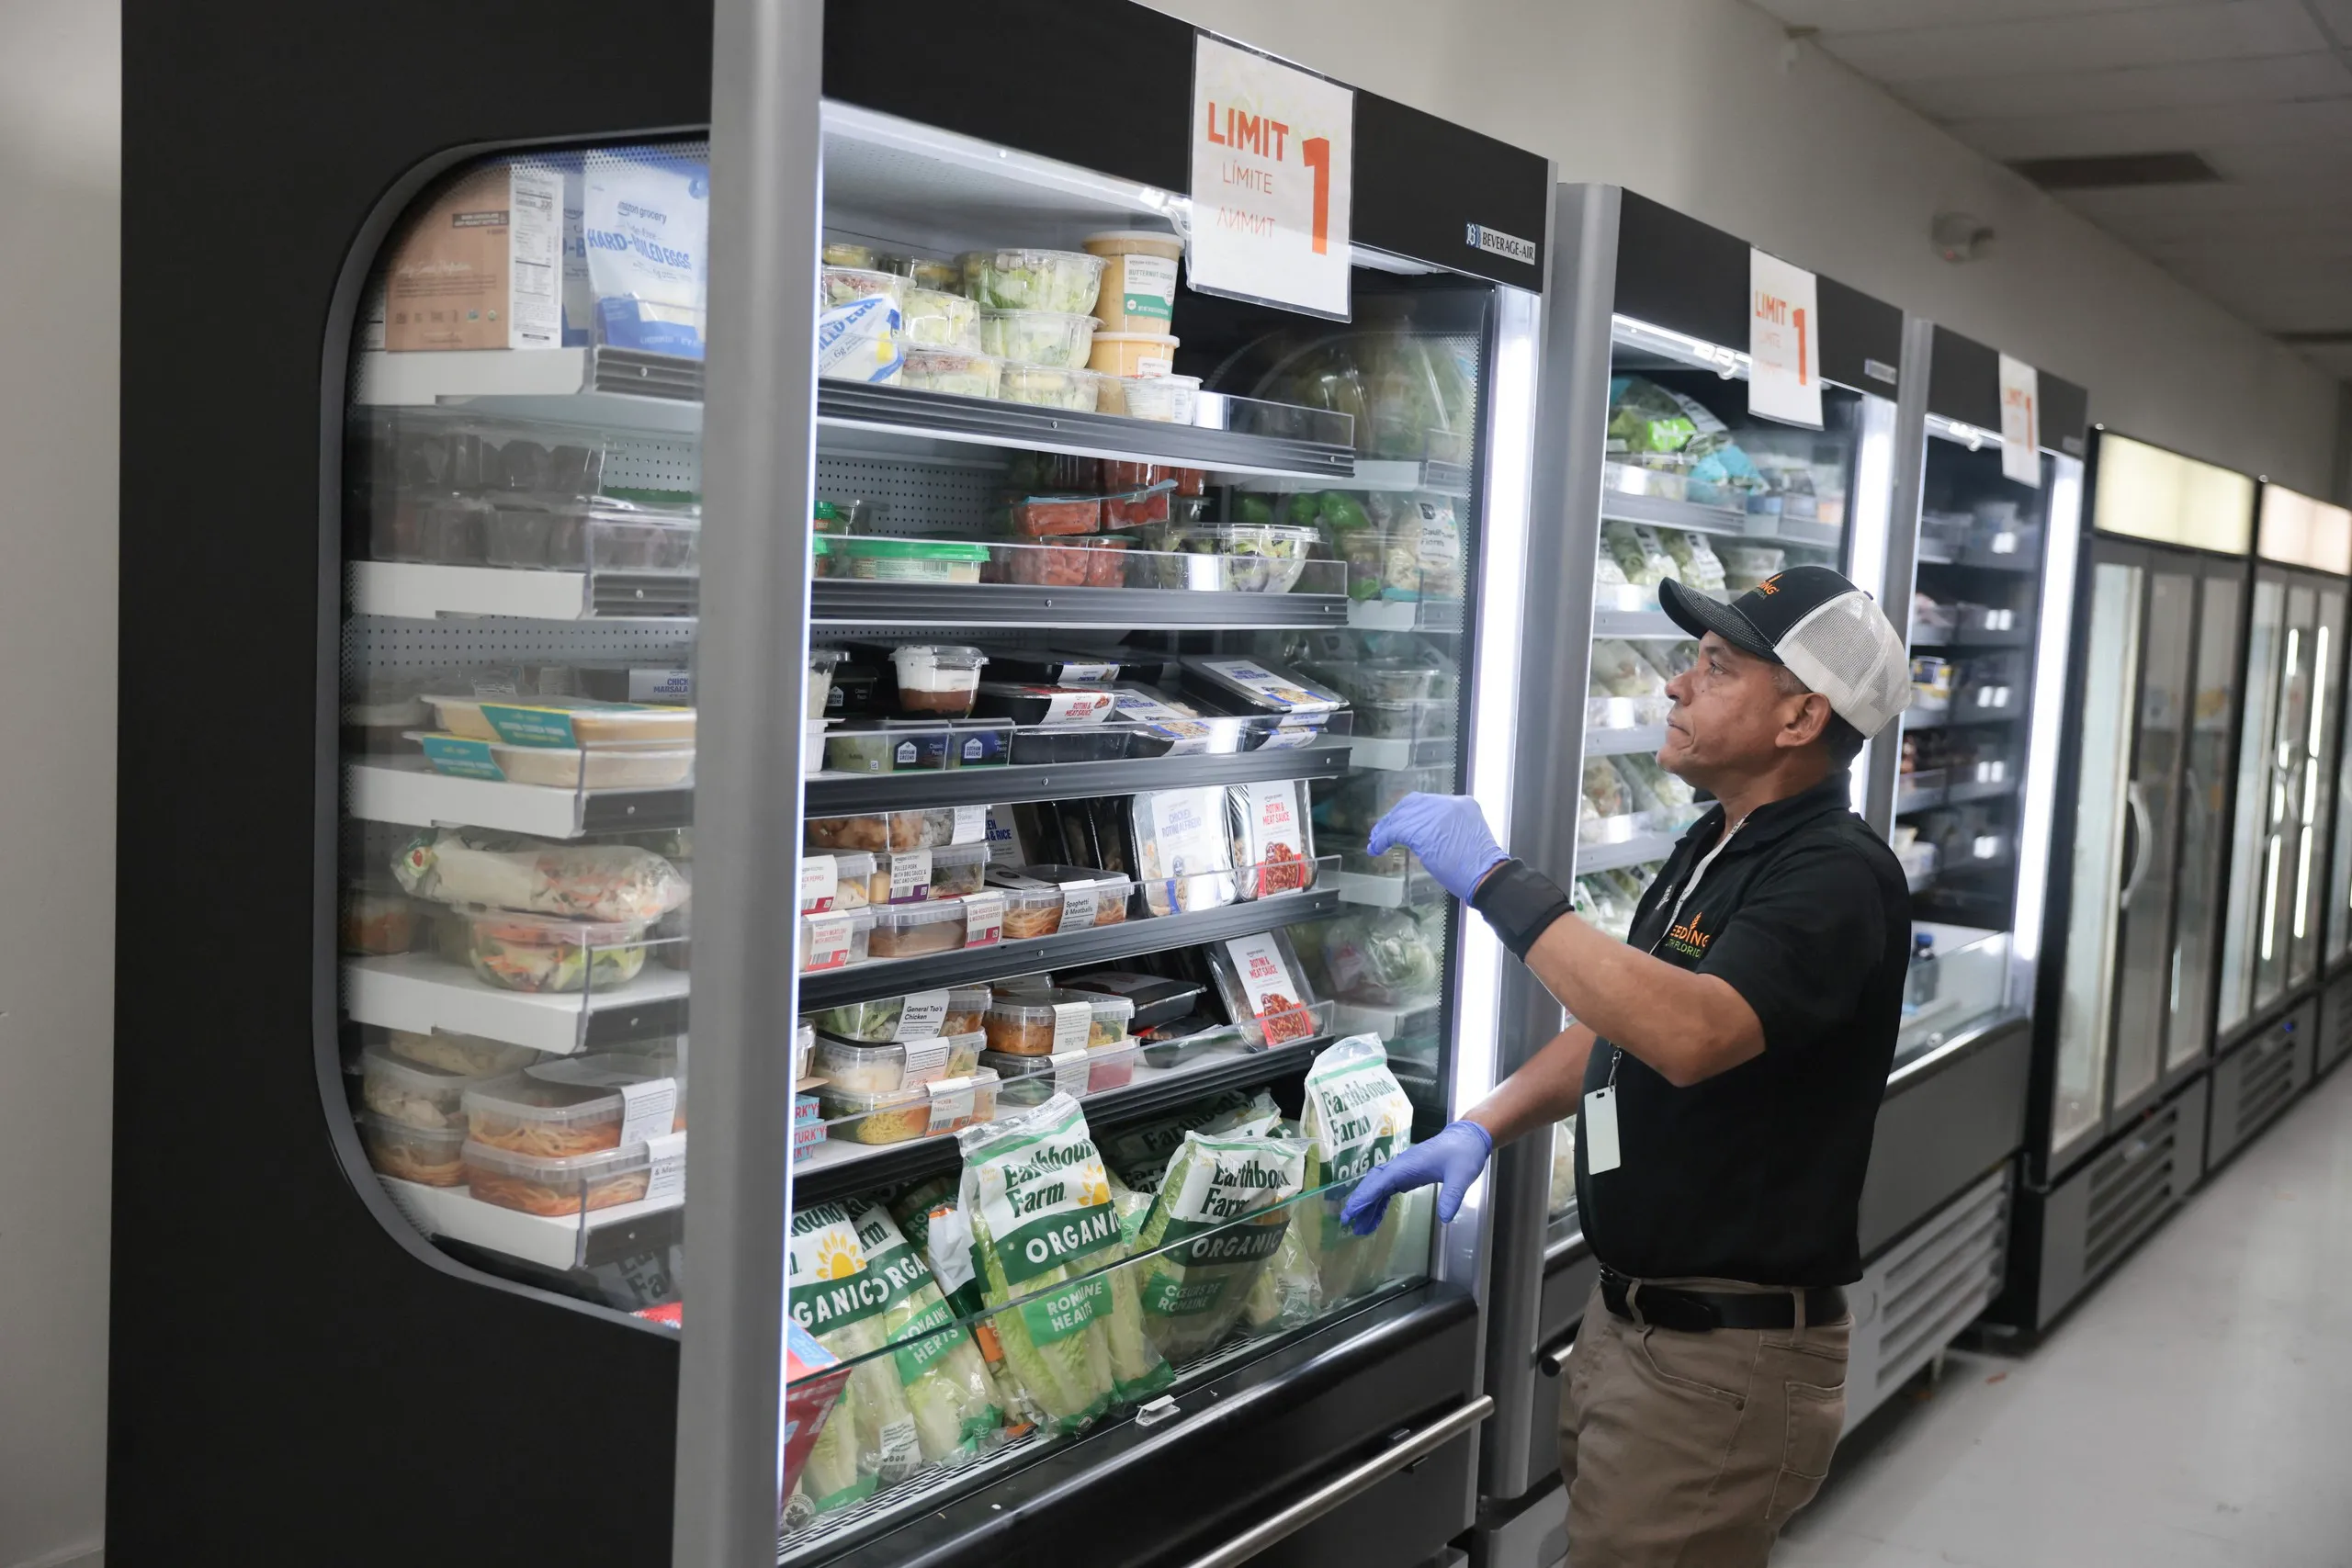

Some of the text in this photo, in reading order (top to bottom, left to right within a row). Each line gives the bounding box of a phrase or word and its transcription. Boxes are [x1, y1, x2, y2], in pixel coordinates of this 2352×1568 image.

[1207, 101, 1289, 162] LIMIT
[1222, 160, 1272, 195] LÍMITE
[1302, 136, 1330, 256] 1
[639, 207, 667, 225] grocery
[1482, 231, 1534, 261] BEVERAGE-AIR
[1128, 268, 1159, 278] BUTTERNUT
[1755, 289, 1786, 326] LIMIT
[1792, 308, 1807, 386] 1
[1073, 702, 1086, 710] ROTINI
[1077, 708, 1093, 716] SAUCE
[1265, 802, 1279, 814] ROTINI
[1262, 811, 1291, 826] MEAT SAUCE
[990, 829, 1012, 841] & RICE
[1066, 897, 1090, 908] Spaghetti
[1069, 906, 1093, 915] Meatballs
[1674, 941, 1703, 958] FLORID
[1250, 956, 1264, 969] ROTINI
[1250, 964, 1278, 979] MEAT SAUCE
[907, 1005, 929, 1013] General
[794, 1125, 827, 1145] TURK'Y
[1329, 1114, 1371, 1146] Farm
[1001, 1138, 1098, 1190] Earthboun
[1211, 1156, 1290, 1190] Earthbo
[1005, 1181, 1066, 1219] Farm
[1192, 1230, 1282, 1258] ORGANIC
[872, 1252, 929, 1303] ORGA
[794, 1279, 874, 1329] GANIC
[1158, 1296, 1209, 1312] ROMAINE
